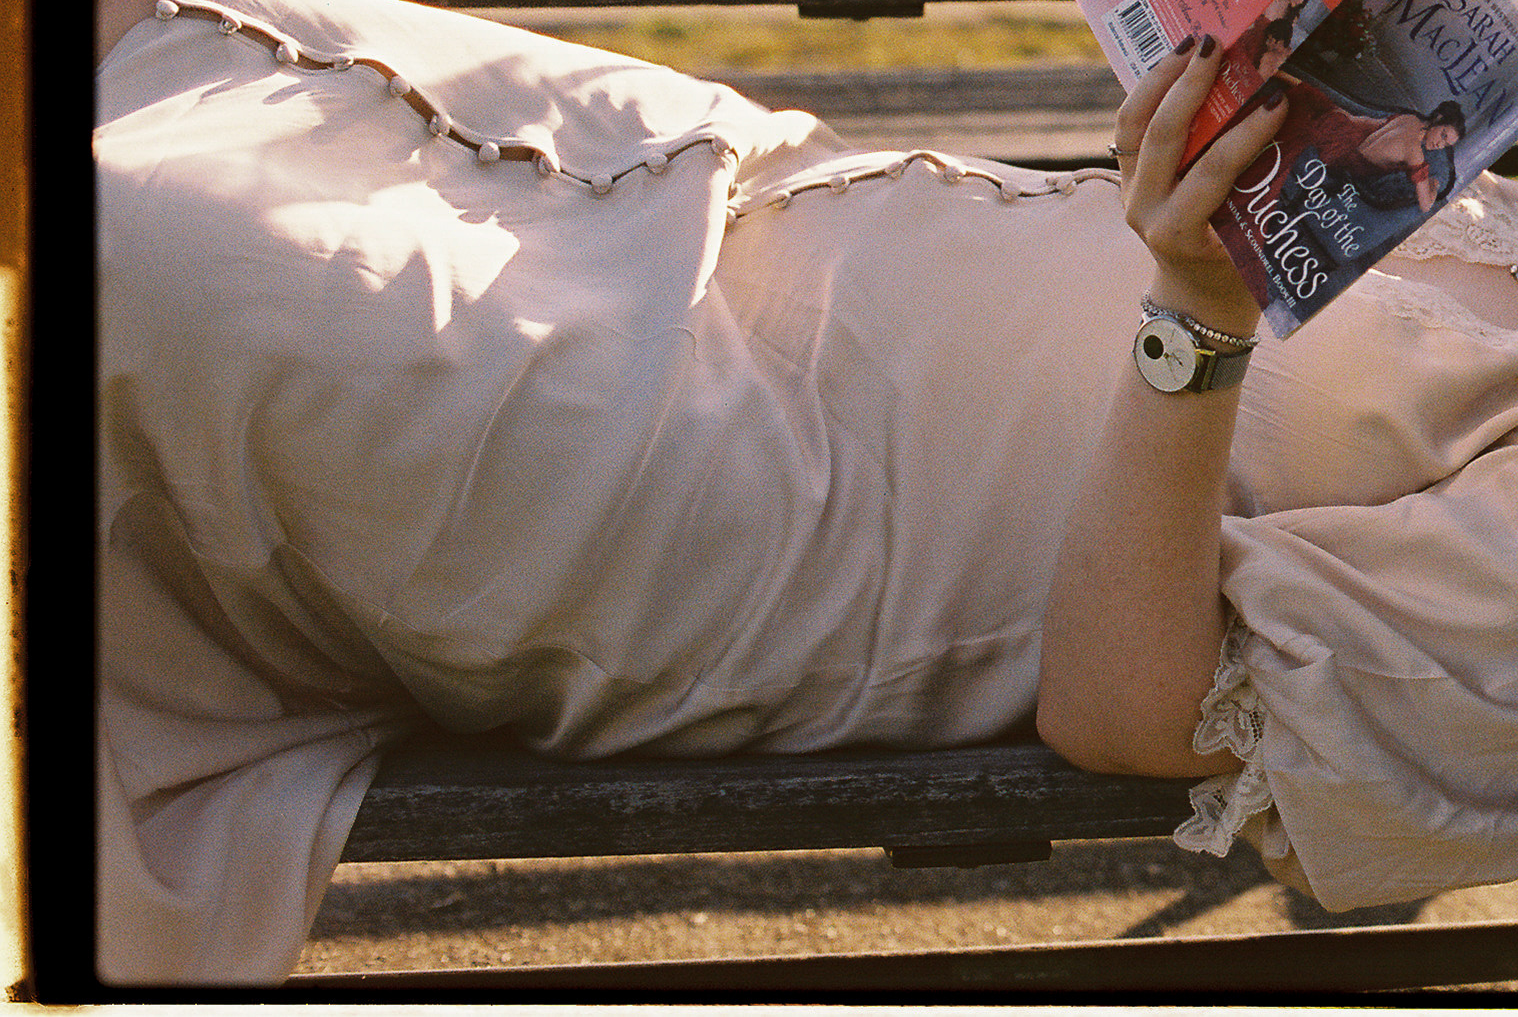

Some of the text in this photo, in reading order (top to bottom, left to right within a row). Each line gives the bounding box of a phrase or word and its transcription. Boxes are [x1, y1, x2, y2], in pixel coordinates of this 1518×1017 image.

[1232, 140, 1329, 297] Duchess
[1294, 160, 1365, 256] Day of the
[1335, 183, 1360, 213] The
[1240, 221, 1248, 230] &
[1286, 296, 1297, 309] III
